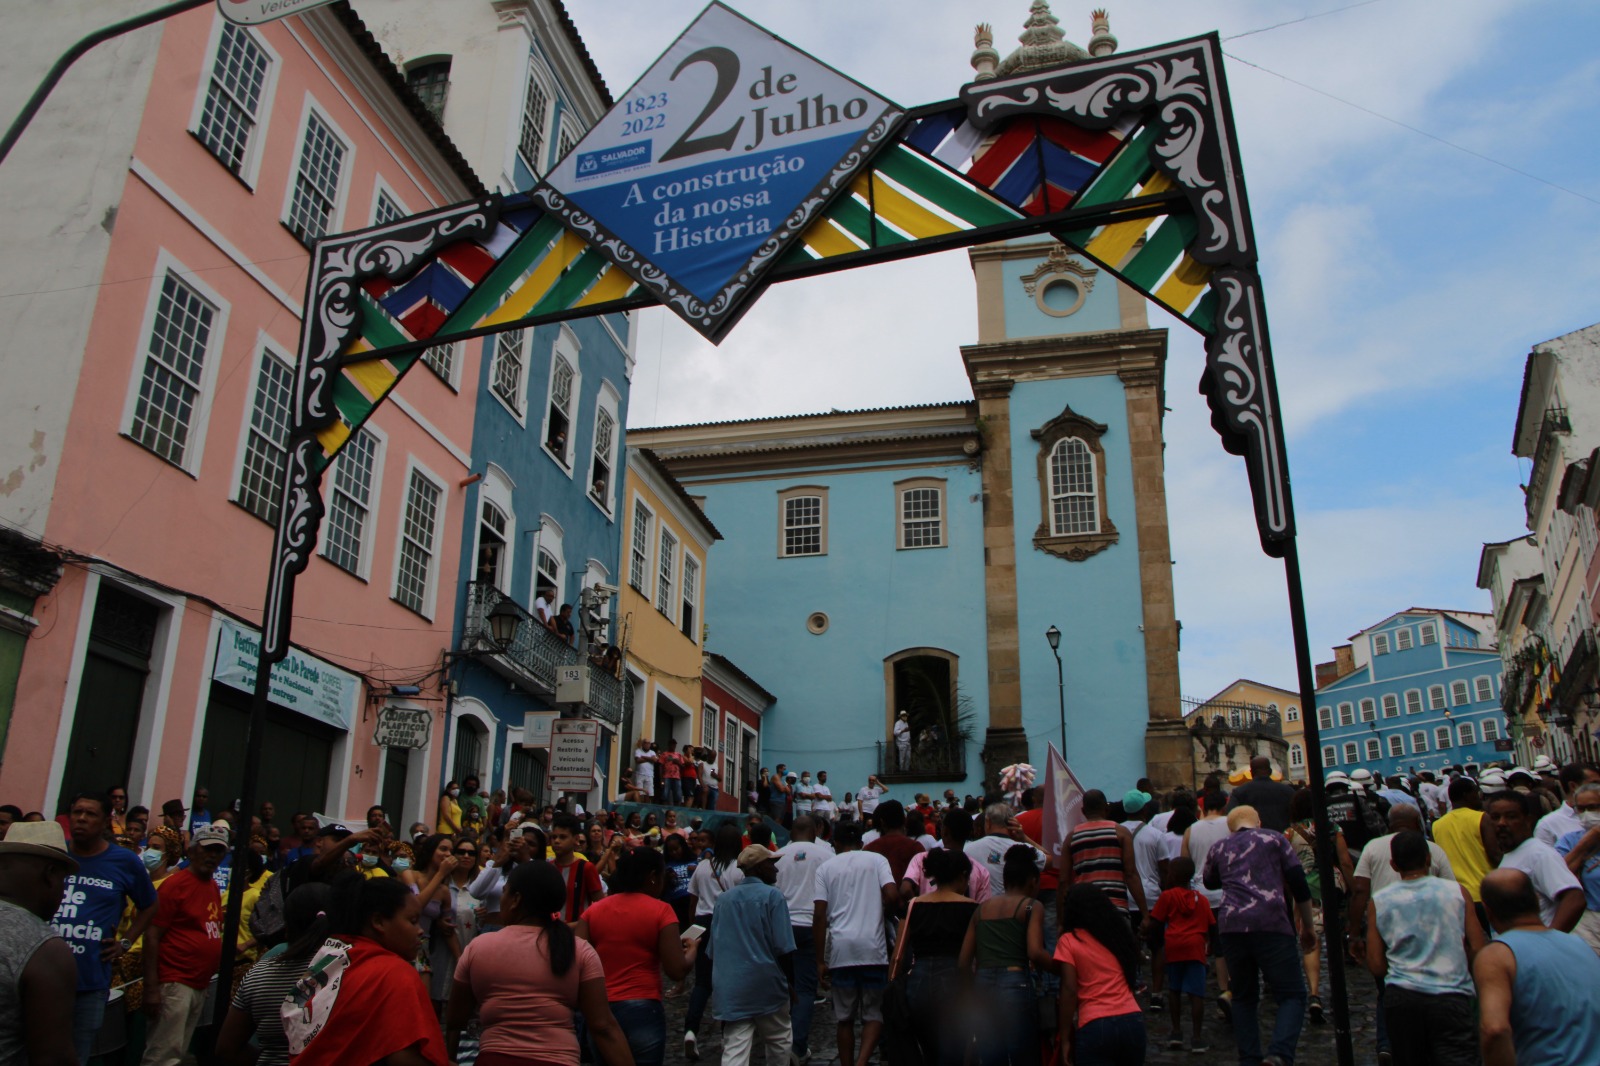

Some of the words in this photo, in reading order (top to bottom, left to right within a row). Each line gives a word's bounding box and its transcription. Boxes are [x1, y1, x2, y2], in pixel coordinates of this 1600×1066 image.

[261, 0, 303, 15] Veicu
[625, 92, 668, 116] 1823
[658, 46, 745, 163] 2
[749, 65, 798, 100] de
[621, 113, 665, 137] 2022
[744, 93, 868, 151] Julho
[601, 146, 645, 163] SALVADOR
[621, 182, 646, 208] A
[652, 155, 805, 201] construção
[654, 202, 687, 227] da
[692, 190, 771, 219] nossa
[652, 214, 772, 255] História
[565, 670, 579, 678] 183
[272, 688, 297, 703] entrega
[78, 876, 113, 890] nossa
[303, 1022, 323, 1047] BRASIL
